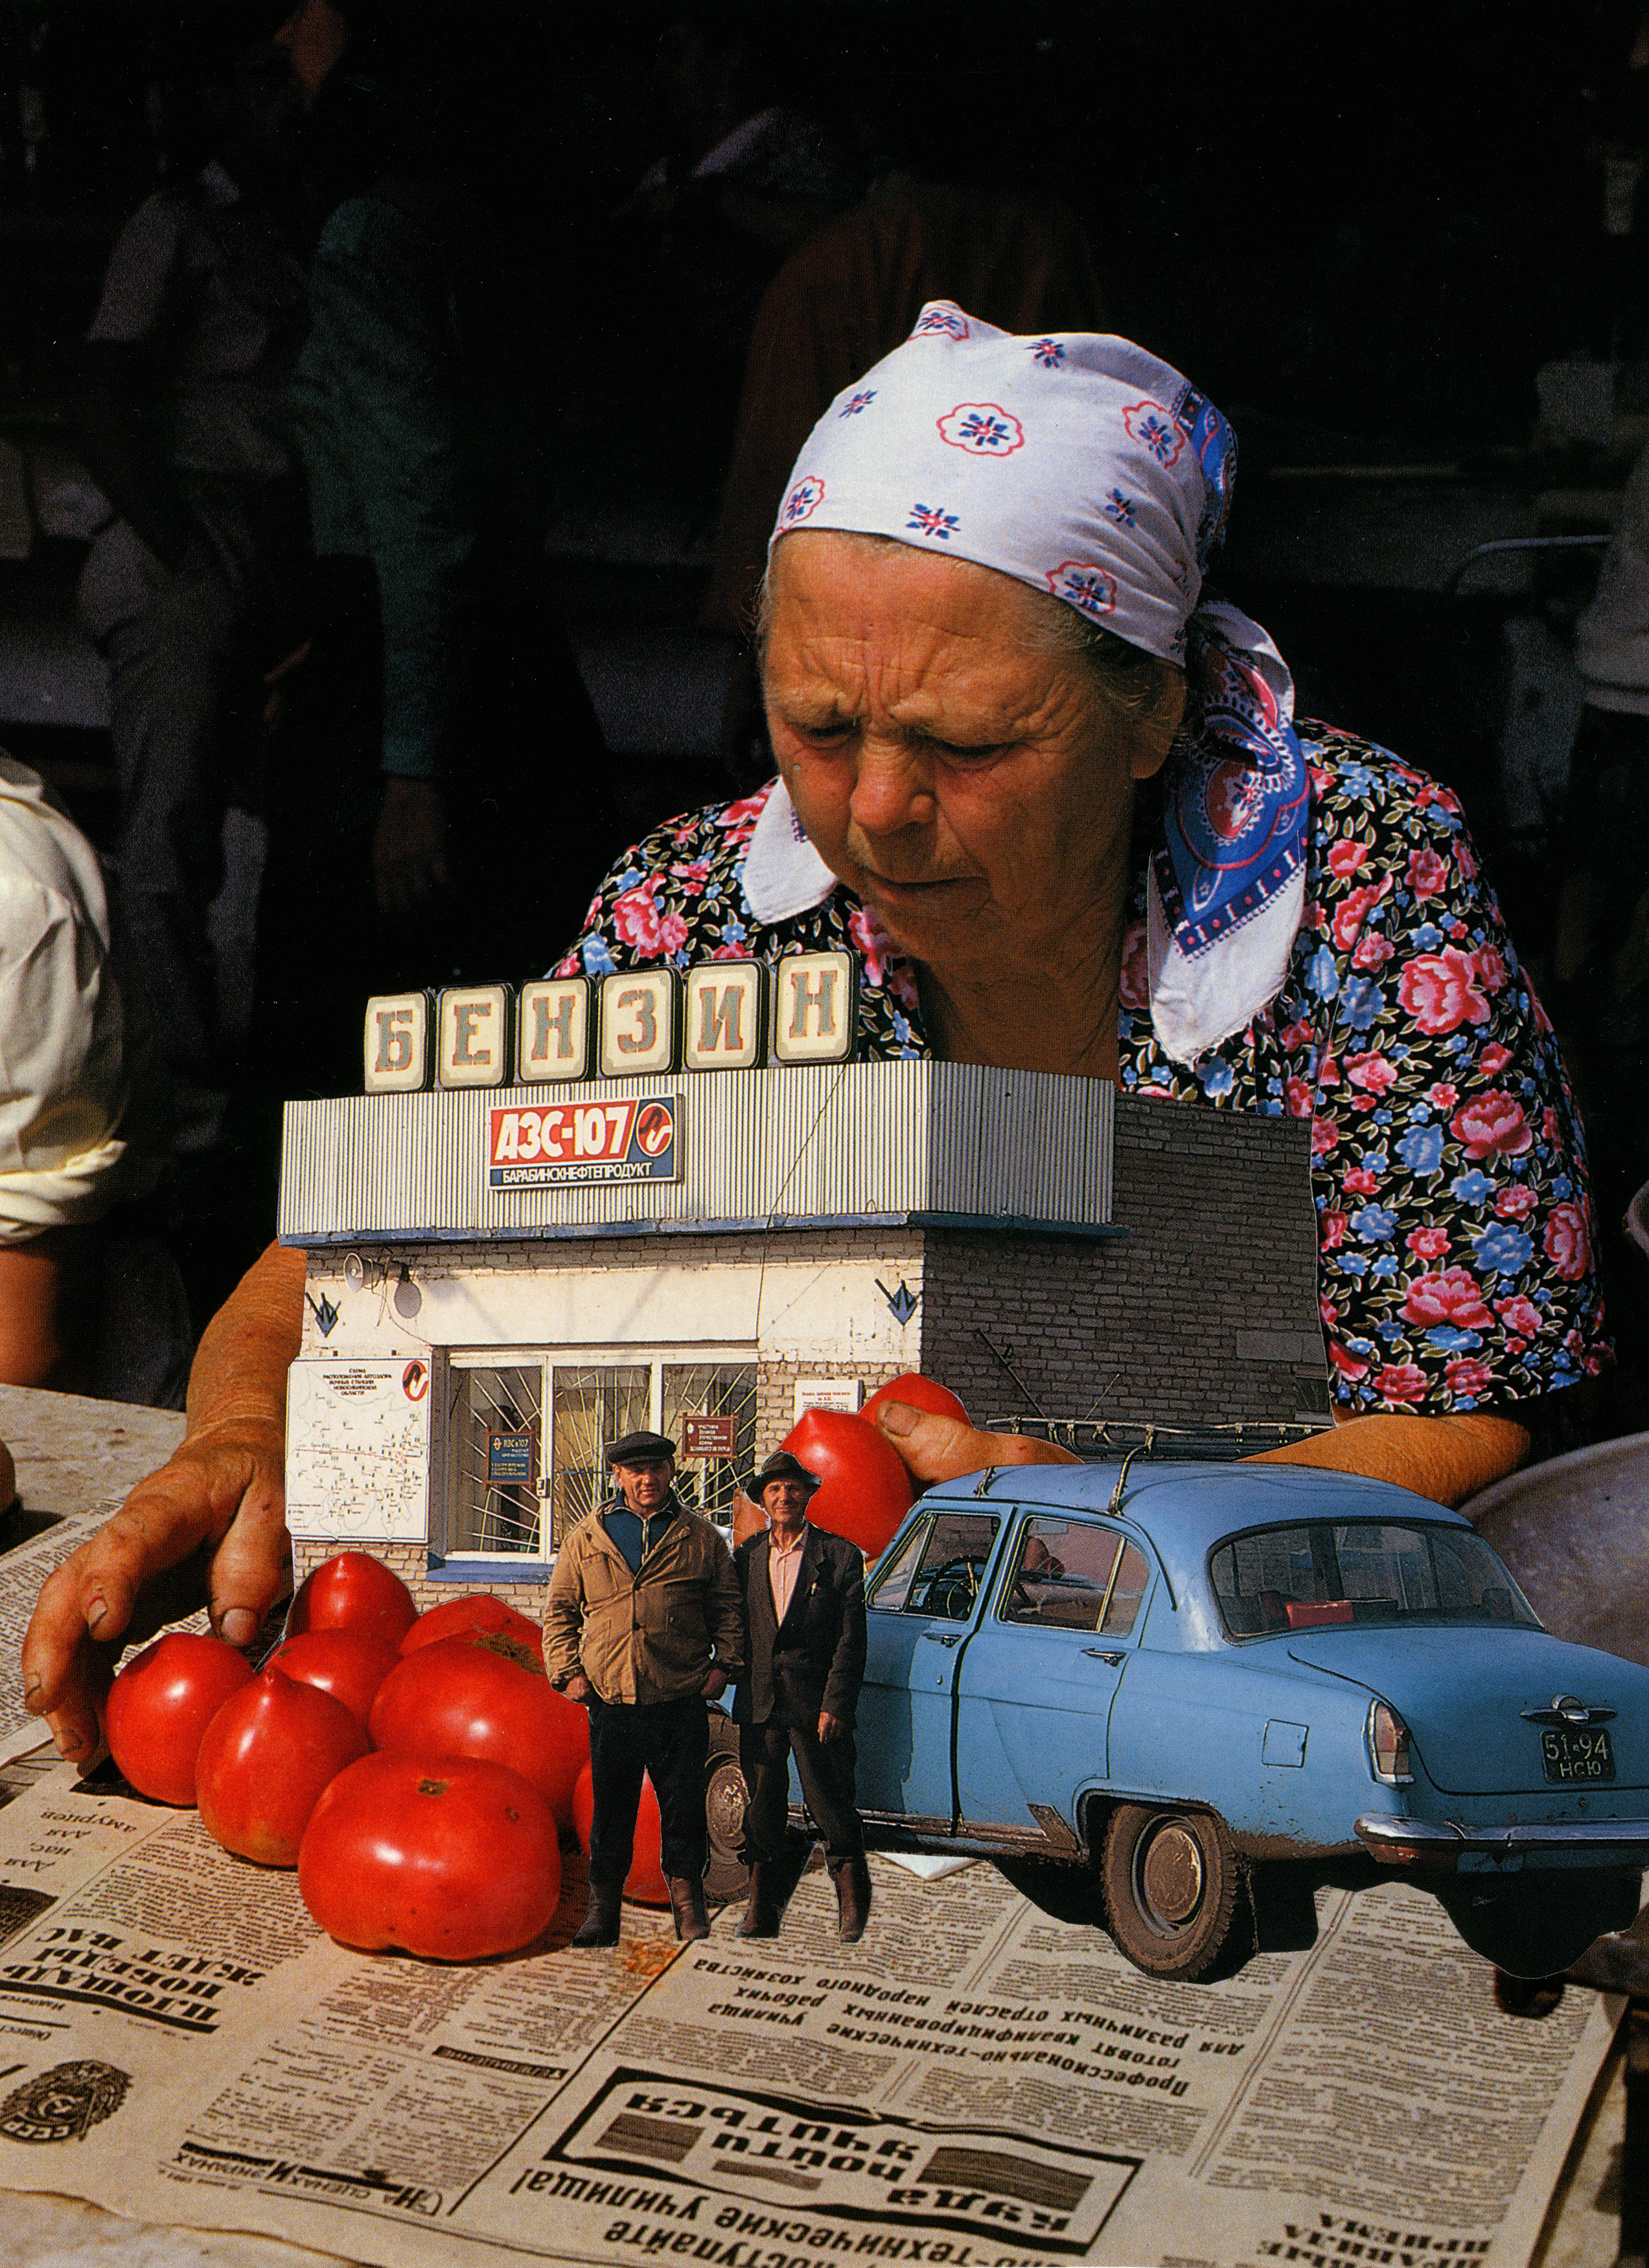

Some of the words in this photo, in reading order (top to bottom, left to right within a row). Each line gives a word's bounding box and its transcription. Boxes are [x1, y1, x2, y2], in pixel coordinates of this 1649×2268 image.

[375, 969, 839, 1072] БЕНЗИН
[494, 1105, 630, 1161] АЗС-107
[502, 1162, 652, 1184] БАРАБИНСКНЕФТЕПРОДУКТ
[1545, 1734, 1608, 1760] 51-94
[1560, 1760, 1601, 1777] НСЮ
[34, 1928, 126, 1951] ВАС
[30, 1947, 225, 1999] ПОБЕДЫ
[131, 1949, 266, 1986] ЖДЕТ
[692, 1958, 806, 1987] хозяйства
[1, 1965, 220, 2022] ПЛОЩАДЬ
[732, 1985, 827, 2009] рабочих
[816, 1978, 931, 2009] народного
[707, 2002, 806, 2028] училища
[842, 2004, 1081, 2047] квалифицированных
[943, 2000, 1049, 2023] отраслей
[1059, 2010, 1190, 2050] различных
[825, 2023, 1190, 2098] Профессионально-технические
[1090, 2041, 1181, 2070] готовят
[1198, 2041, 1245, 2056] для
[624, 2093, 919, 2161] учиться
[711, 2133, 905, 2182] пойти
[508, 2168, 709, 2221] училища!
